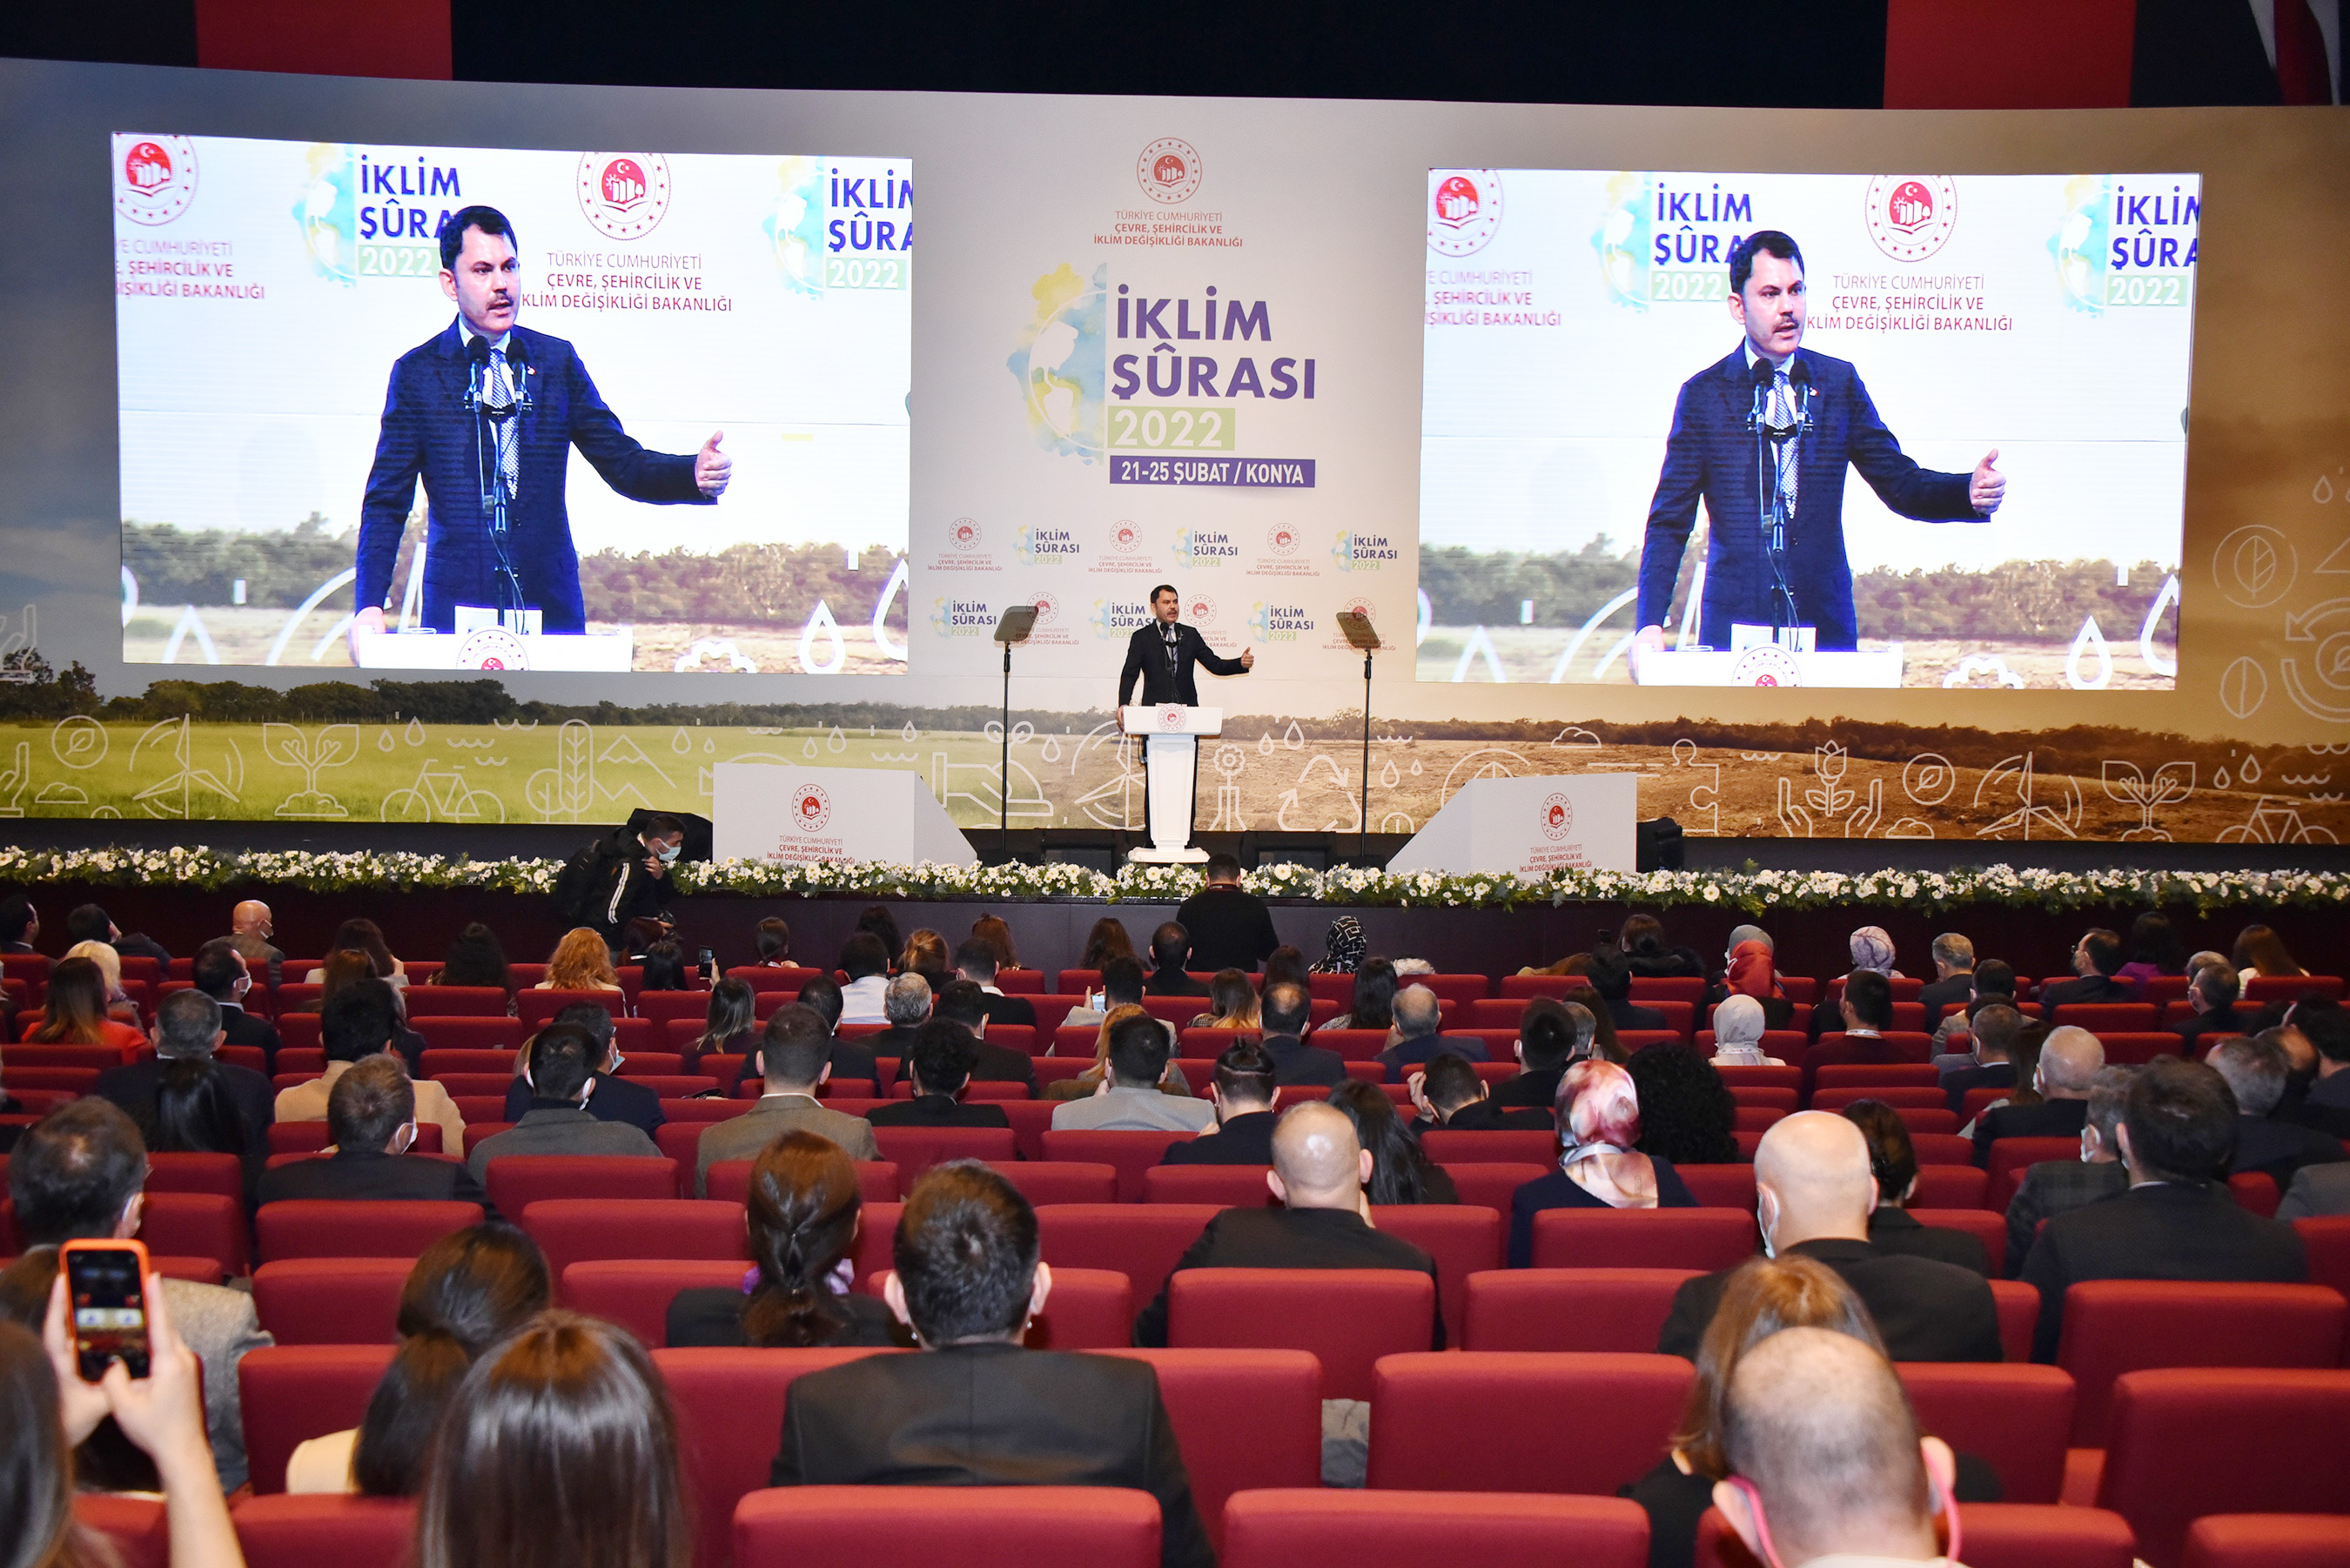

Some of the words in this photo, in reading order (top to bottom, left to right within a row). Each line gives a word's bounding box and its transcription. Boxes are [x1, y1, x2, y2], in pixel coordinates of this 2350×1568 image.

[361, 154, 460, 197] İKLİM
[1658, 182, 1752, 222] İKLİM
[360, 198, 453, 239] ŞÛRA
[1115, 209, 1154, 220] TÜRKİYE
[1157, 211, 1223, 222] CUMHURİYETİ
[1115, 223, 1150, 234] ÇEVRE,
[1152, 222, 1207, 235] ŞEHİRCİLİK
[1209, 225, 1223, 234] VE
[1094, 233, 1122, 245] İKLİM
[1125, 235, 1185, 248] DEĞİŞİKLİĞİ
[1187, 236, 1243, 247] BAKANLIĞI
[1655, 224, 1742, 265] ŞÛRA
[362, 246, 433, 277] 2022
[547, 250, 602, 268] TÜRKİYE
[607, 251, 702, 270] CUMHURİYETİ
[129, 259, 211, 278] ŞEHİRCİLİK
[214, 263, 233, 277] VE
[829, 259, 898, 288] 2022
[547, 273, 597, 291] ÇEVRE,
[601, 272, 681, 291] ŞEHİRCİLİK
[684, 277, 702, 290] VE
[1655, 272, 1722, 301] 2022
[1833, 272, 1887, 290] TÜRKİYE
[1891, 273, 1984, 290] CUMHURİYETİ
[182, 283, 265, 299] BAKANLIĞI
[2111, 276, 2180, 305] 2022
[522, 291, 557, 307] KLİM
[561, 291, 648, 312] DEĞİŞİKLİĞİ
[652, 295, 731, 312] BAKANLIĞI
[1434, 289, 1511, 308] ŞEHİRCİLİK
[1514, 292, 1532, 305] VE
[1832, 296, 1880, 312] ÇEVRE,
[1884, 294, 1962, 313] ŞEHİRCİLİK
[1965, 297, 1984, 310] VE
[1118, 284, 1272, 341] İKLİM
[1483, 310, 1561, 326] BAKANLIĞI
[1807, 313, 1841, 330] KLİM
[1846, 313, 1930, 333] DEĞİŞİKLİĞİ
[1934, 314, 2012, 332] BAKANLIĞI
[1111, 342, 1315, 400] ŞÛRASI
[1114, 409, 1222, 447] 2022
[1121, 460, 1170, 482] 21-25
[1173, 462, 1230, 485] ŞUBAT
[1246, 463, 1304, 484] KONYA
[1036, 528, 1070, 540] İKLİM
[1195, 531, 1228, 543] İKLİM
[1354, 534, 1387, 546] İKLİM
[1035, 541, 1079, 553] ŞÛRASI
[1193, 544, 1238, 556] ŞÛRASI
[1353, 547, 1397, 560] ŞÛRASI
[1036, 555, 1060, 564] 2022
[1194, 558, 1218, 566] 2022
[1353, 561, 1377, 570] 2022
[953, 600, 987, 613] İKLİM
[1111, 602, 1145, 614] İKLİM
[1271, 605, 1304, 617] İKLİM
[952, 613, 997, 625] ŞÛRASI
[1111, 615, 1155, 627] ŞÛRAS
[1270, 618, 1313, 630] ŞÛRASI
[1270, 632, 1293, 640] 2022
[767, 851, 783, 860] İKLİM
[801, 845, 834, 854] ŞEHİRCİLİK
[1548, 854, 1574, 862] ŞEHİRCİLİK
[1520, 864, 1534, 873] İKLİM
